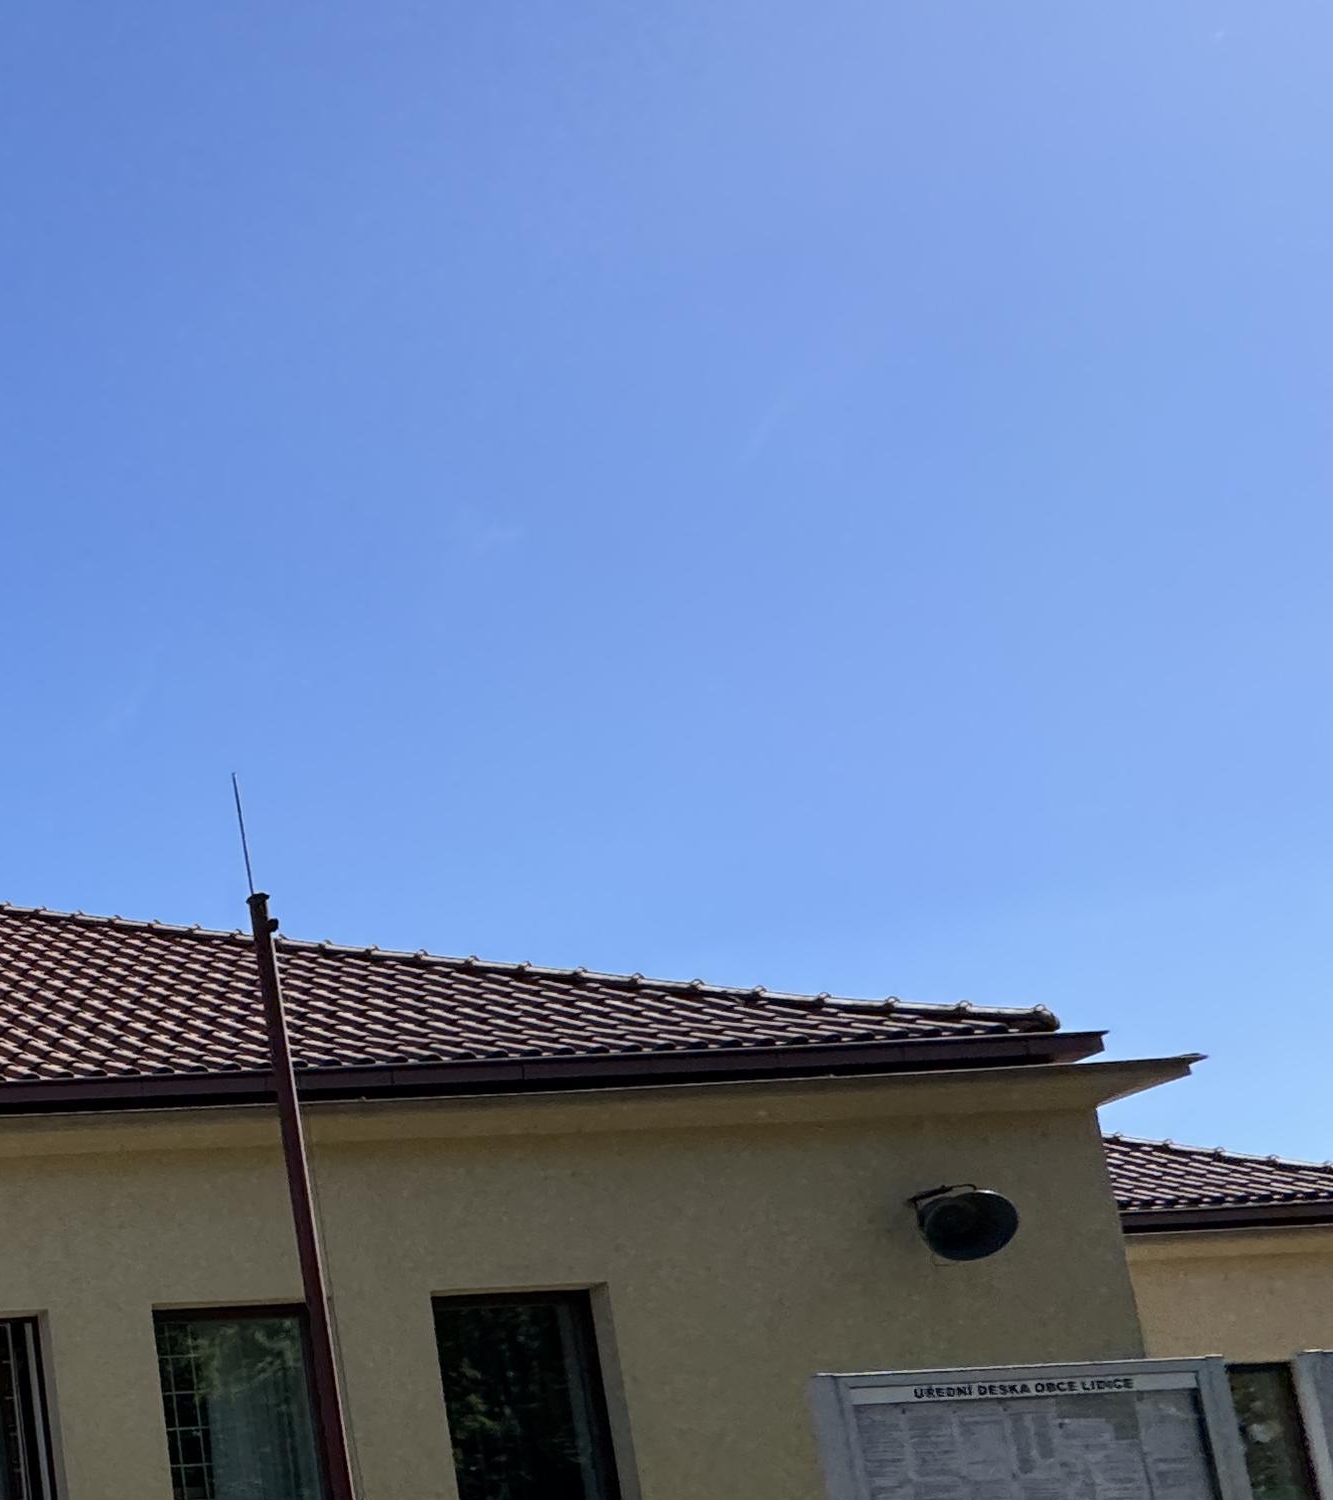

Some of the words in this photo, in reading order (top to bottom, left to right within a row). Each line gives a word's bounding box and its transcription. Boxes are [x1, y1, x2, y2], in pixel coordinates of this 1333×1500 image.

[978, 1384, 1031, 1396] DESKA
[1035, 1381, 1078, 1393] OBCE
[1081, 1378, 1134, 1392] LIDICE
